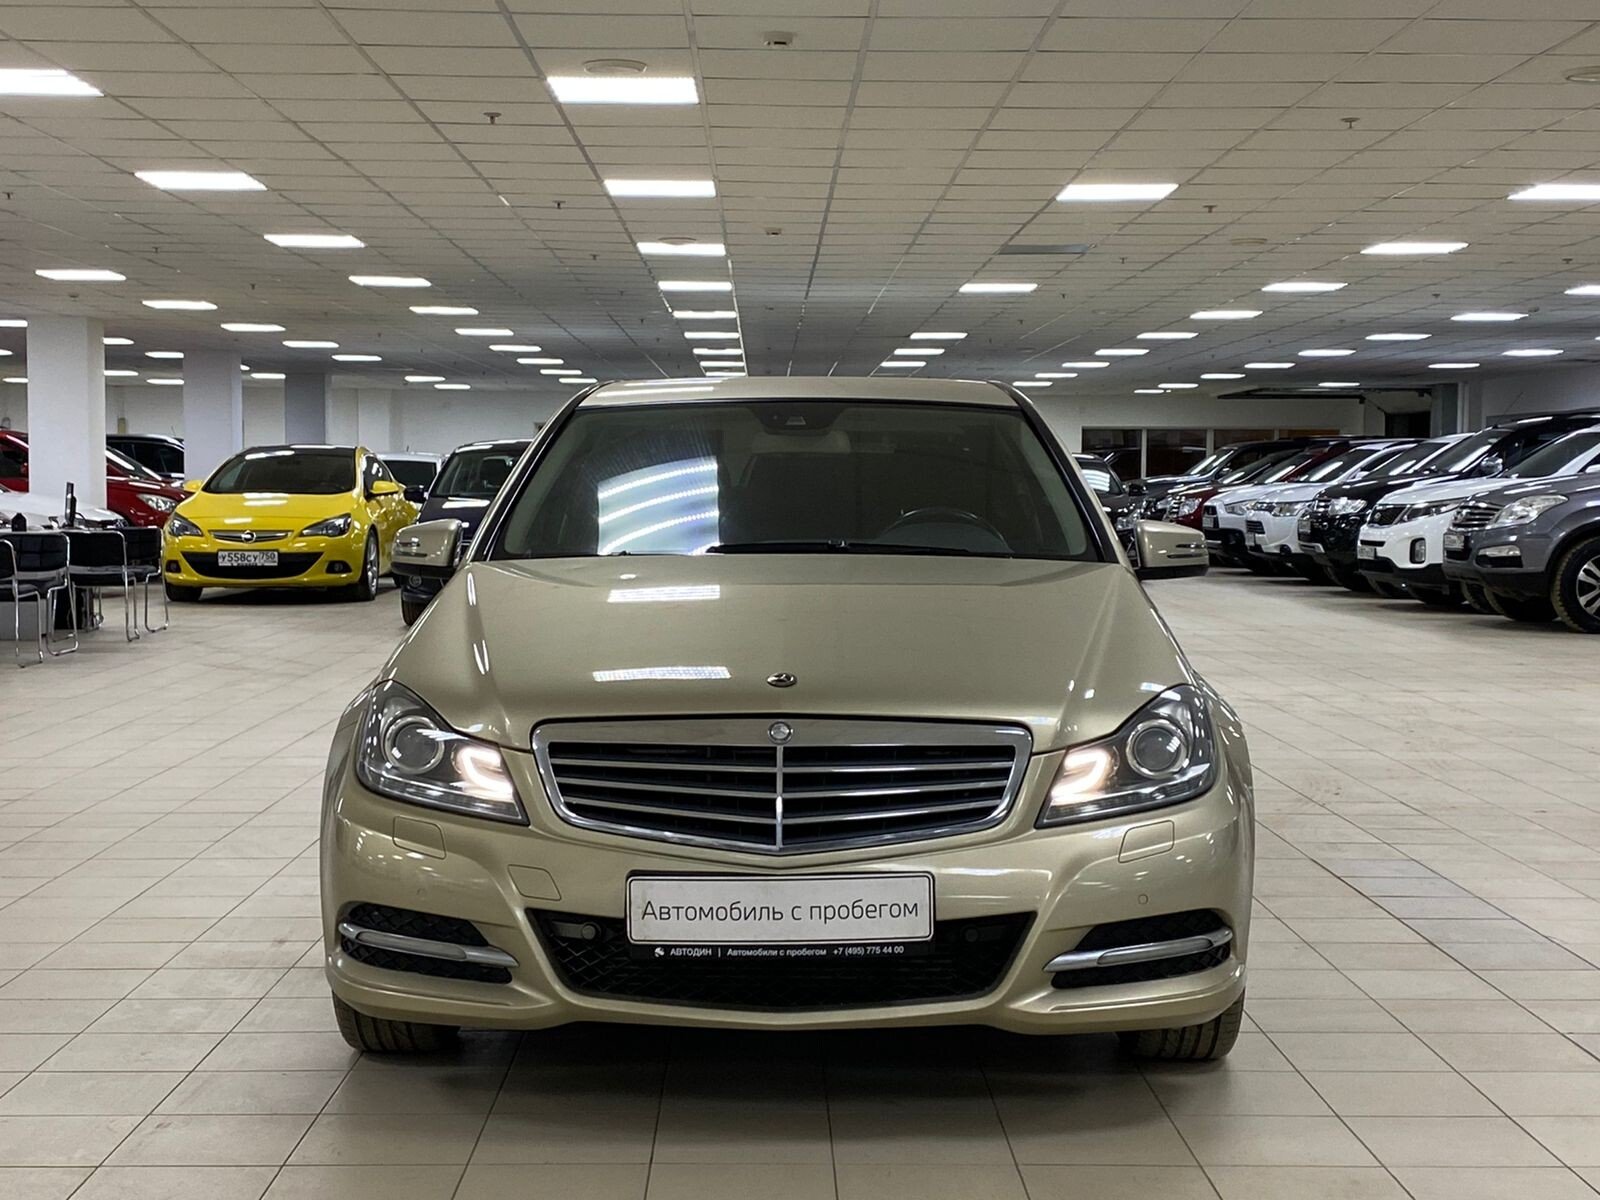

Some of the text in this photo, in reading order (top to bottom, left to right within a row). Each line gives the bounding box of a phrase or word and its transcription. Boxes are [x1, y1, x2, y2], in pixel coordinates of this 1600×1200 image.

[641, 898, 919, 925] Автомобиль с пробегом
[670, 947, 713, 957] АВТОДИН
[726, 947, 778, 957] Автомобили
[786, 946, 827, 958] пробегом
[845, 946, 865, 957] (495)
[882, 945, 893, 954] 44
[894, 945, 905, 954] 00
